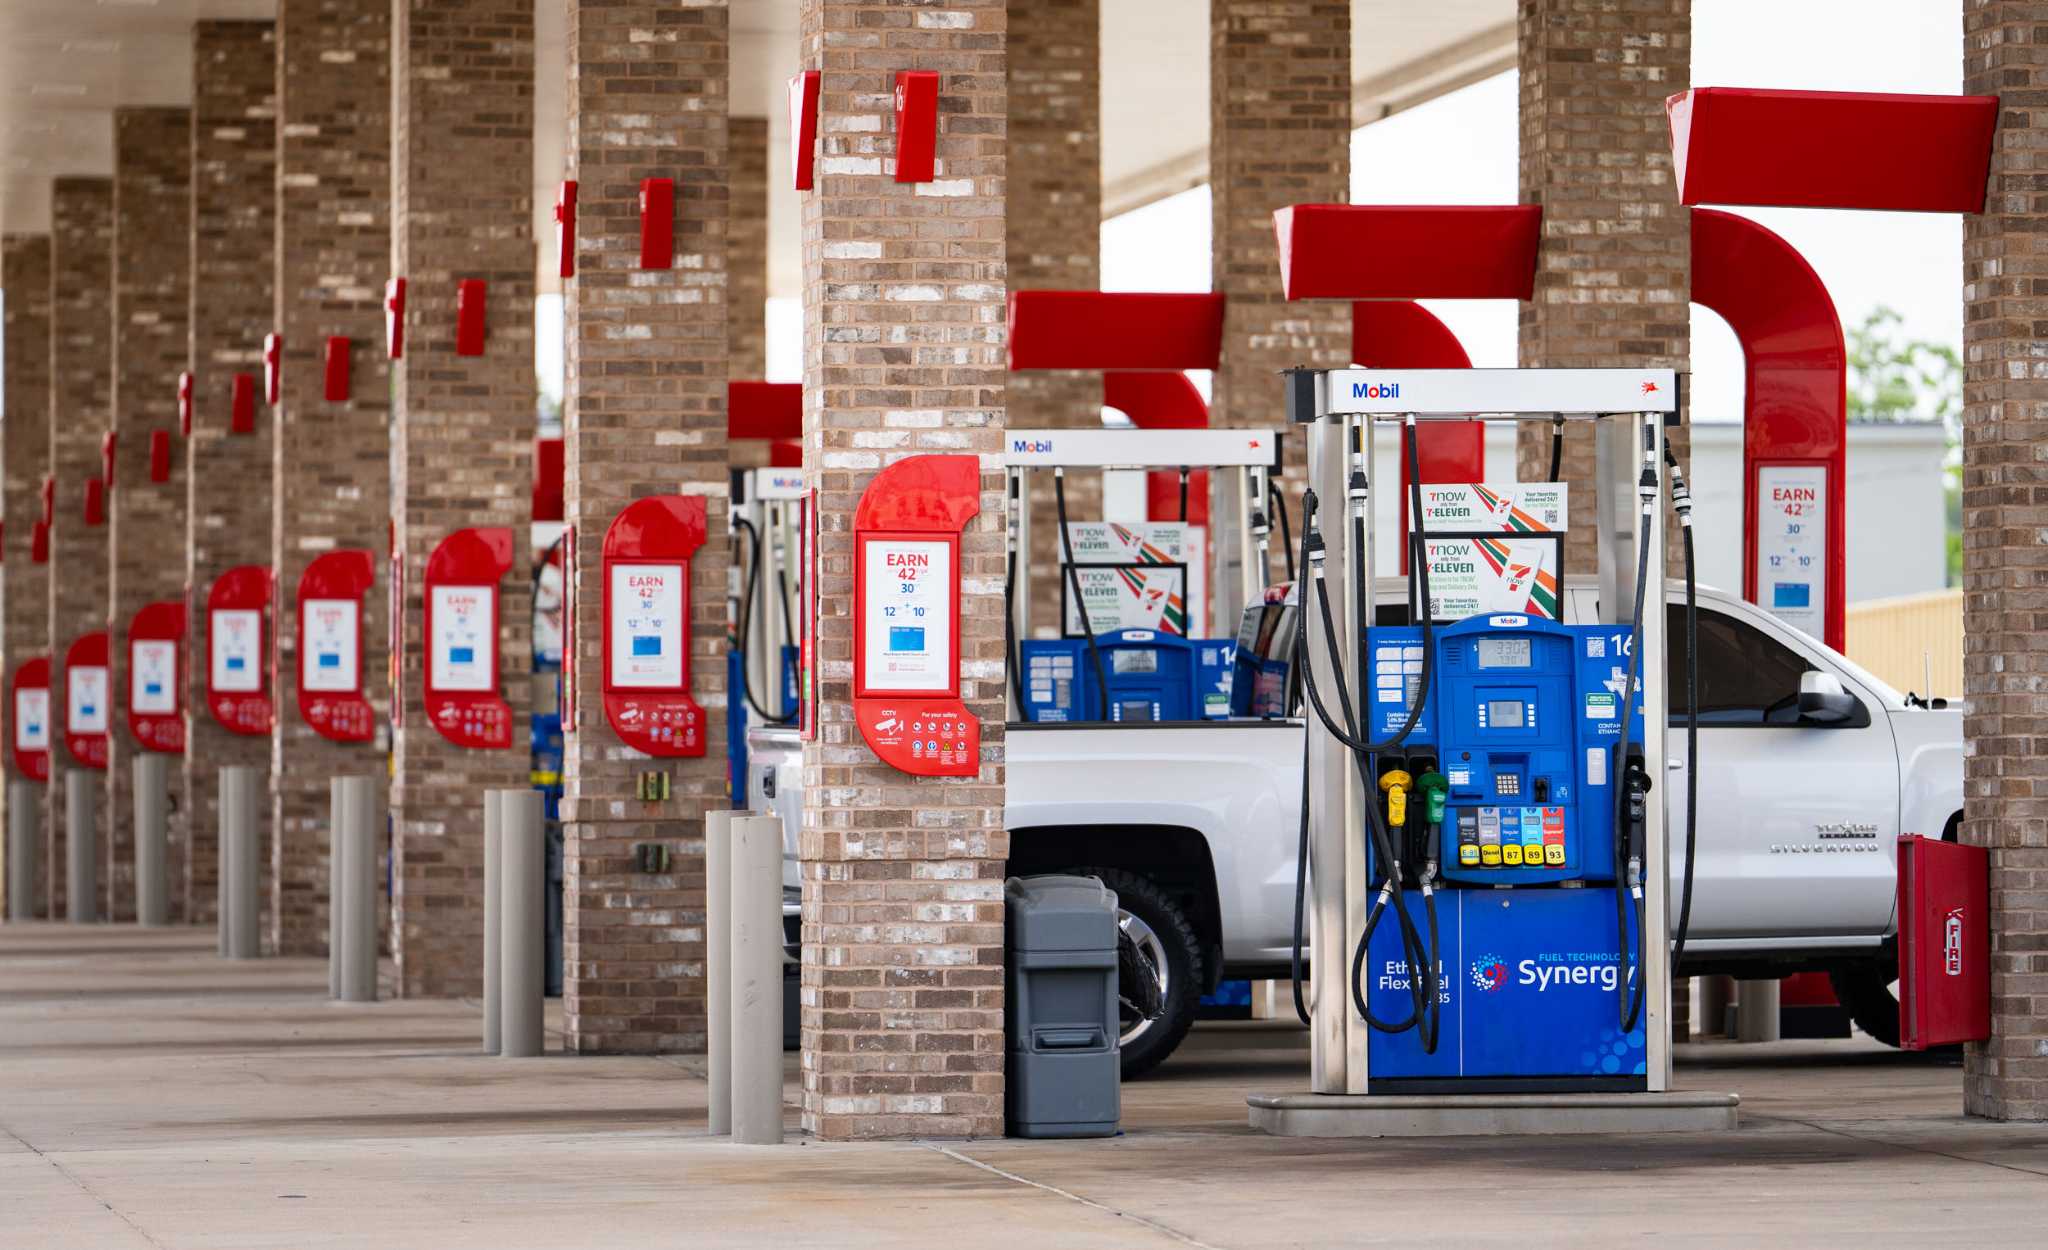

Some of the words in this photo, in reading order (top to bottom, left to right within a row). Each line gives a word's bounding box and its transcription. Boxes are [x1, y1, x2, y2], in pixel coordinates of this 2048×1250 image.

[1353, 383, 1399, 398] Mobil
[1014, 440, 1052, 453] Mobil
[1773, 488, 1815, 501] EARN
[1784, 504, 1802, 516] 42
[1787, 524, 1800, 534] 30
[887, 554, 928, 566] EARN
[898, 568, 916, 580] 42
[629, 576, 664, 587] EARN
[639, 588, 653, 598] 42
[901, 584, 914, 593] 30
[884, 607, 896, 616] 12
[913, 607, 925, 616] 10
[1507, 851, 1518, 859] 87
[1528, 851, 1540, 859] 89
[1949, 925, 1959, 971] FIRE
[1539, 953, 1563, 961] FUEL
[1566, 953, 1635, 961] TECHNOLOY
[1380, 976, 1411, 990] Flex
[1418, 975, 1448, 990] Fel
